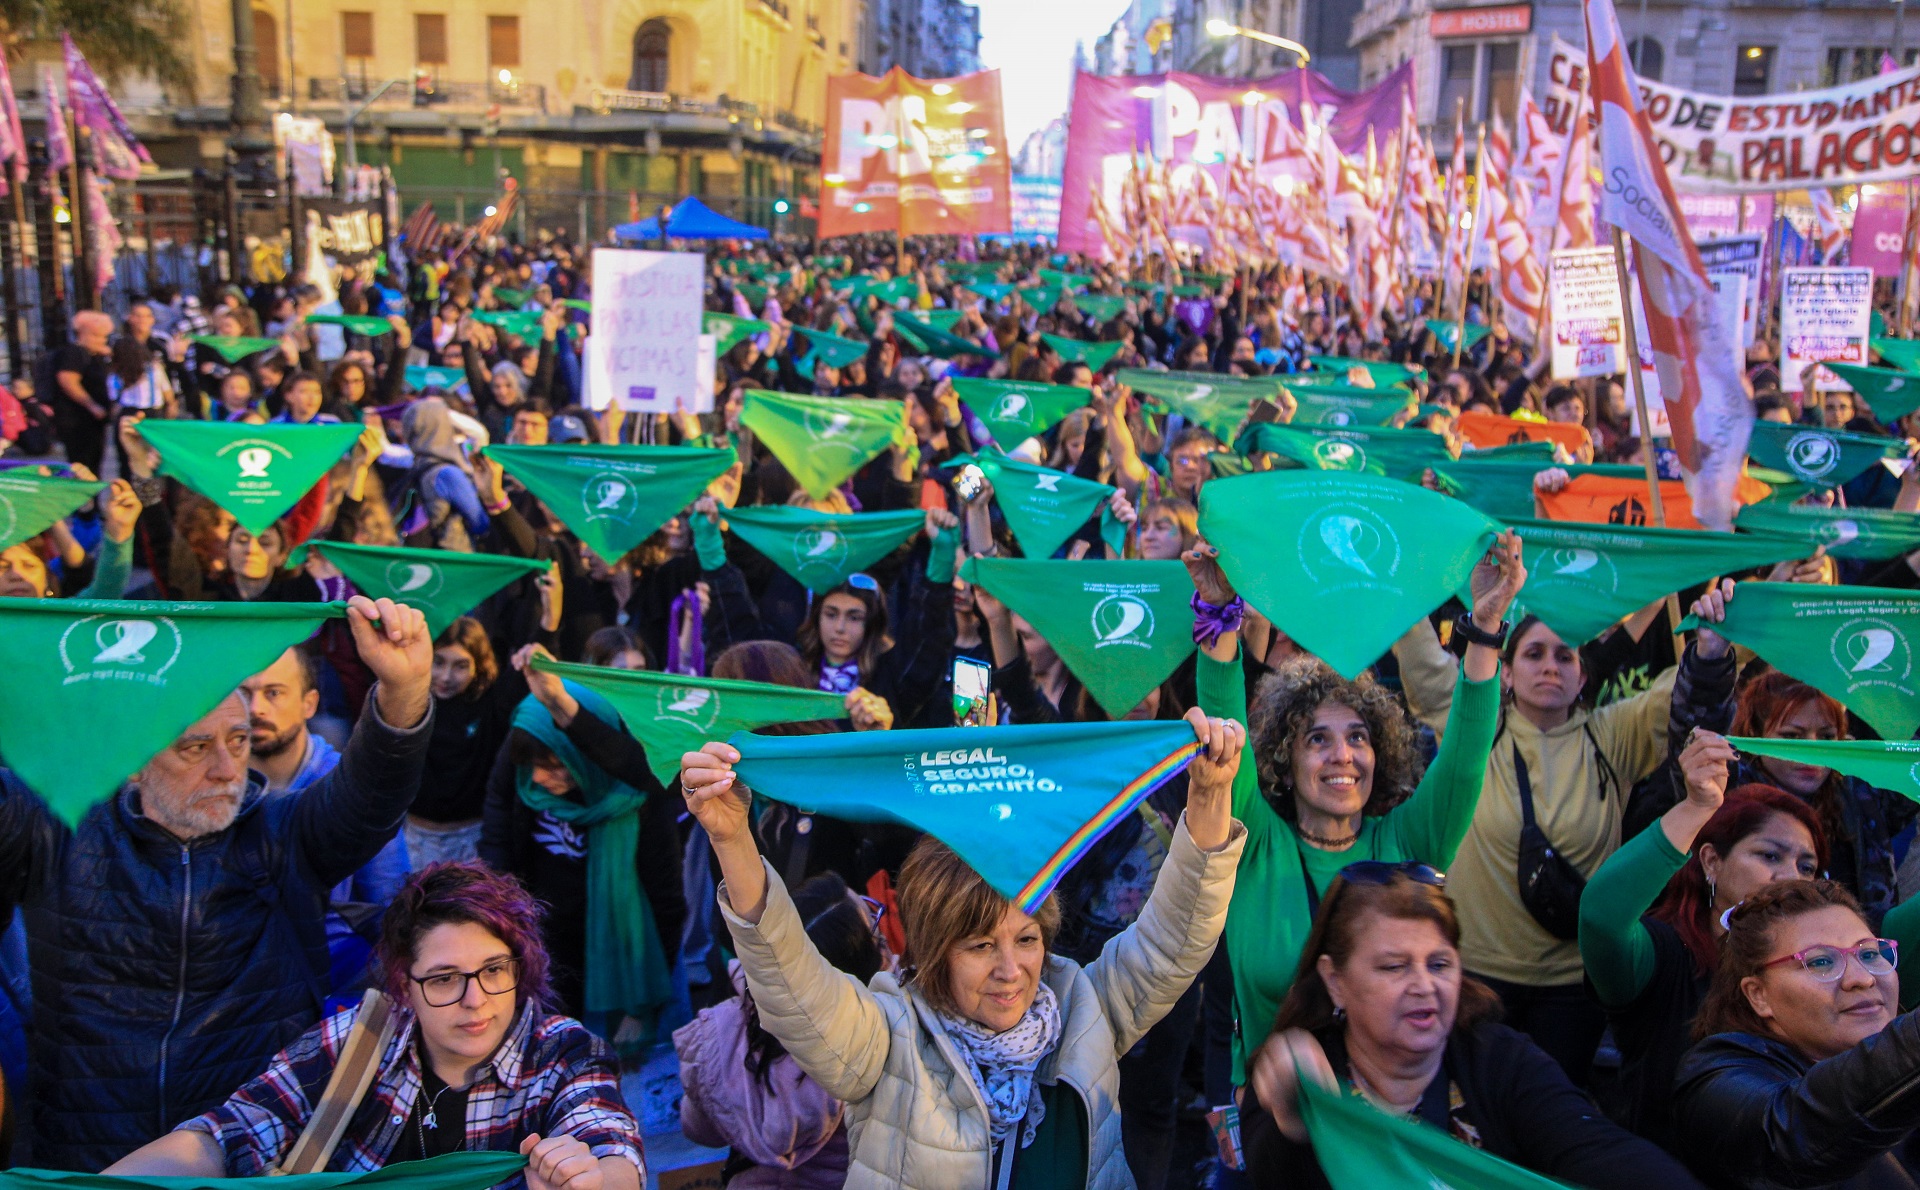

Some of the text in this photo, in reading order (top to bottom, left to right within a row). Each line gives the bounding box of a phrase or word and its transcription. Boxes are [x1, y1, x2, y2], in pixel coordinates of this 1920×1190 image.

[1461, 13, 1522, 30] HOSTEL
[1671, 96, 1723, 131] DE
[658, 310, 696, 341] LAS
[1806, 608, 1836, 617] Aborto
[1838, 607, 1866, 615] Legal,
[1868, 606, 1900, 614] Seguro
[1836, 599, 1876, 607] Nacional
[1878, 599, 1893, 607] Por
[920, 747, 1008, 767] LEGAL,
[923, 763, 1035, 782] SEGURO,
[929, 777, 1063, 796] GRATUITO.
